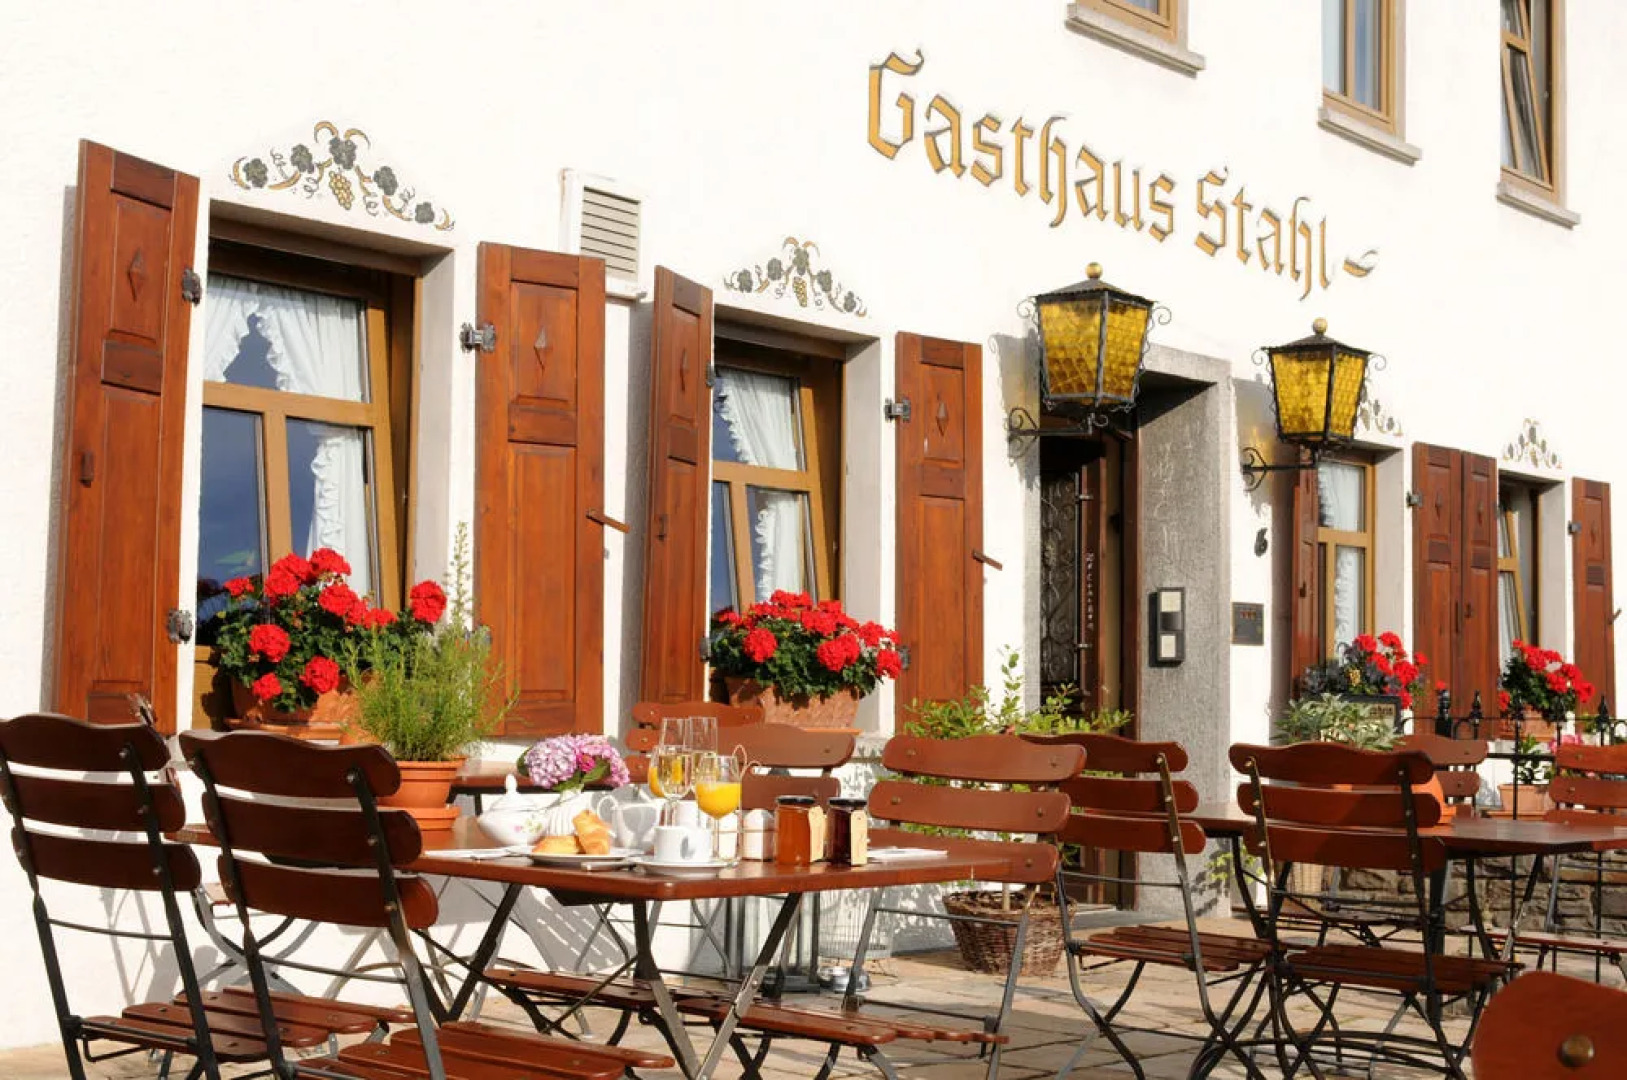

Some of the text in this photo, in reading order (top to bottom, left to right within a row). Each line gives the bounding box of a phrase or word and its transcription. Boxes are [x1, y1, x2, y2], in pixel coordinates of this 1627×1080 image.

[867, 48, 1331, 301] Gasthaus Stahl
[1254, 527, 1268, 557] 6
